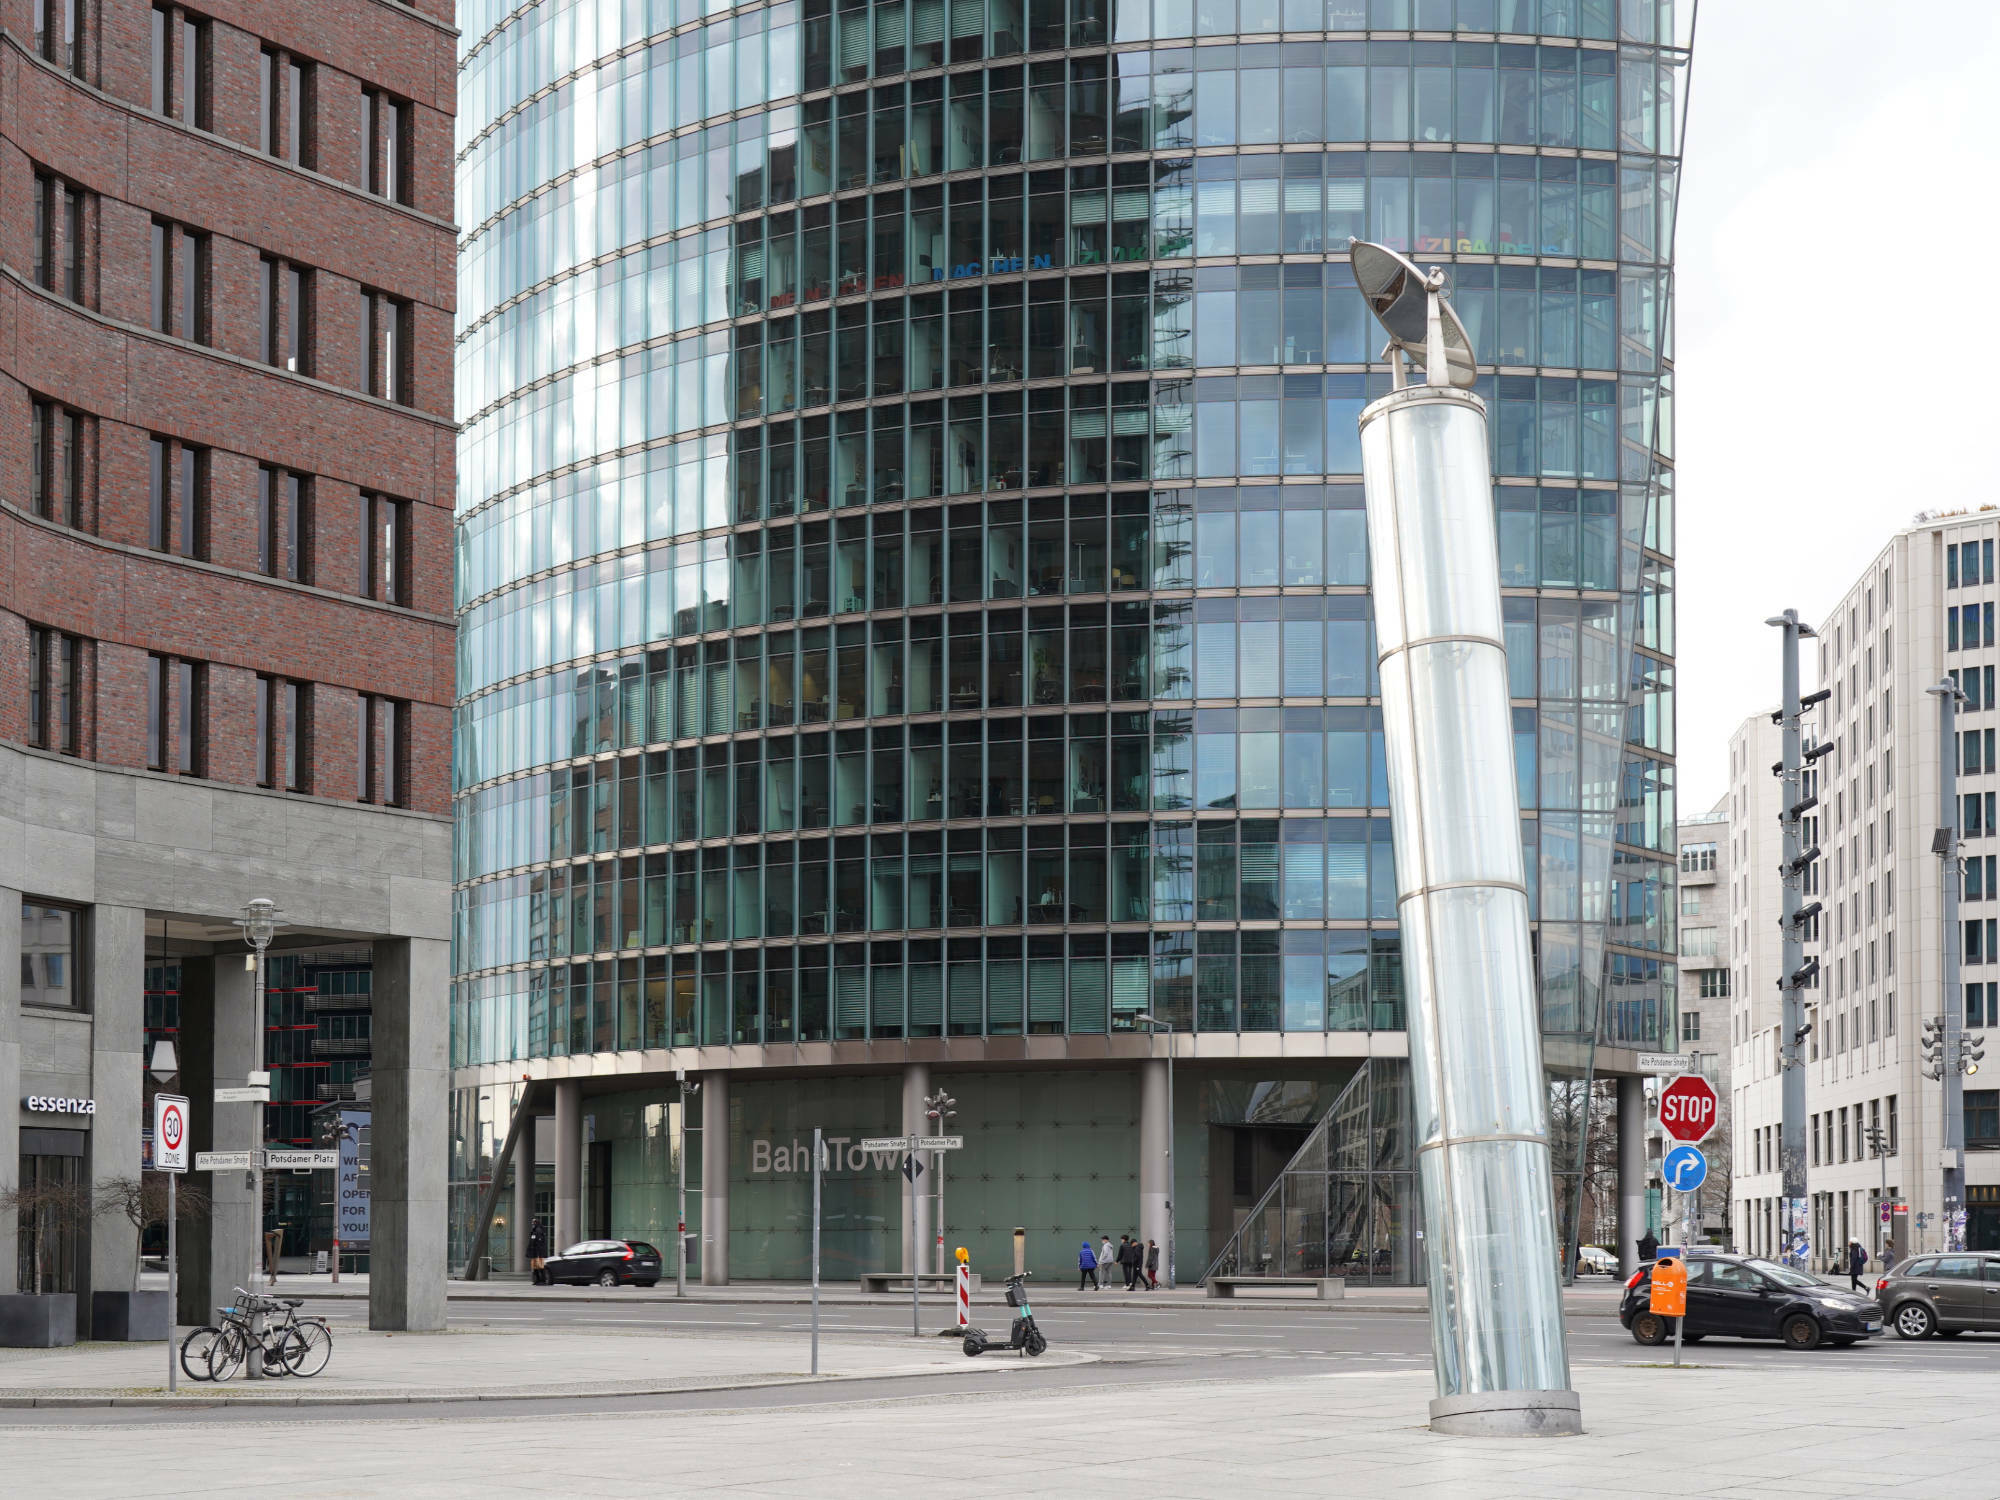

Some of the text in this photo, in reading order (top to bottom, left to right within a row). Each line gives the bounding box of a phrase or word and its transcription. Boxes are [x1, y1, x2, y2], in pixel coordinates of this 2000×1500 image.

[1641, 1058, 1649, 1066] Alte
[1651, 1058, 1672, 1066] Potsdamer
[28, 1095, 96, 1114] essenza
[1664, 1094, 1713, 1123] STOP
[166, 1117, 179, 1137] 30
[164, 1152, 180, 1165] ZONE
[270, 1154, 334, 1164] Potsdamer Platz
[752, 1137, 935, 1173] BahTow
[199, 1157, 209, 1165] Alte
[210, 1156, 233, 1165] Potsdamer
[343, 1156, 359, 1166] WE
[342, 1206, 366, 1216] FOR
[342, 1223, 369, 1232] YOU!
